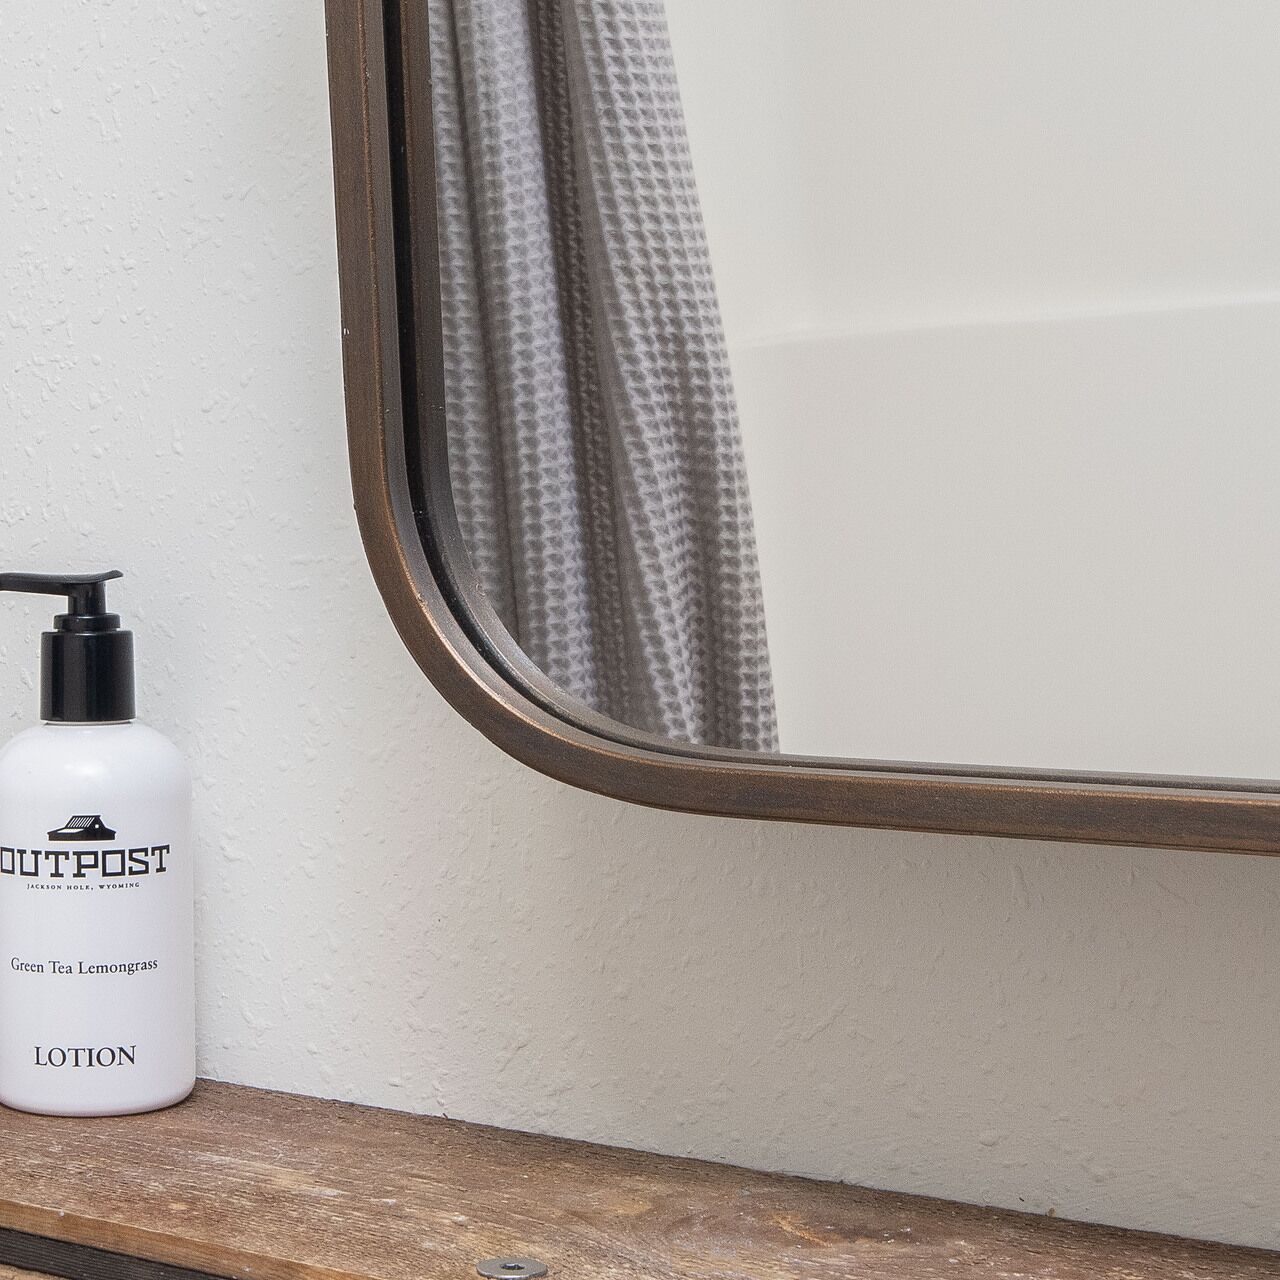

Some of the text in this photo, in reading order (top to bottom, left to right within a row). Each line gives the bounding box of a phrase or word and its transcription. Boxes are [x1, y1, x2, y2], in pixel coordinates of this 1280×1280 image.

[0, 844, 170, 878] OUTPOST
[99, 882, 140, 890] WYOMING
[11, 957, 158, 976] Green Tea Lemongrass
[34, 1045, 136, 1068] LOTION
